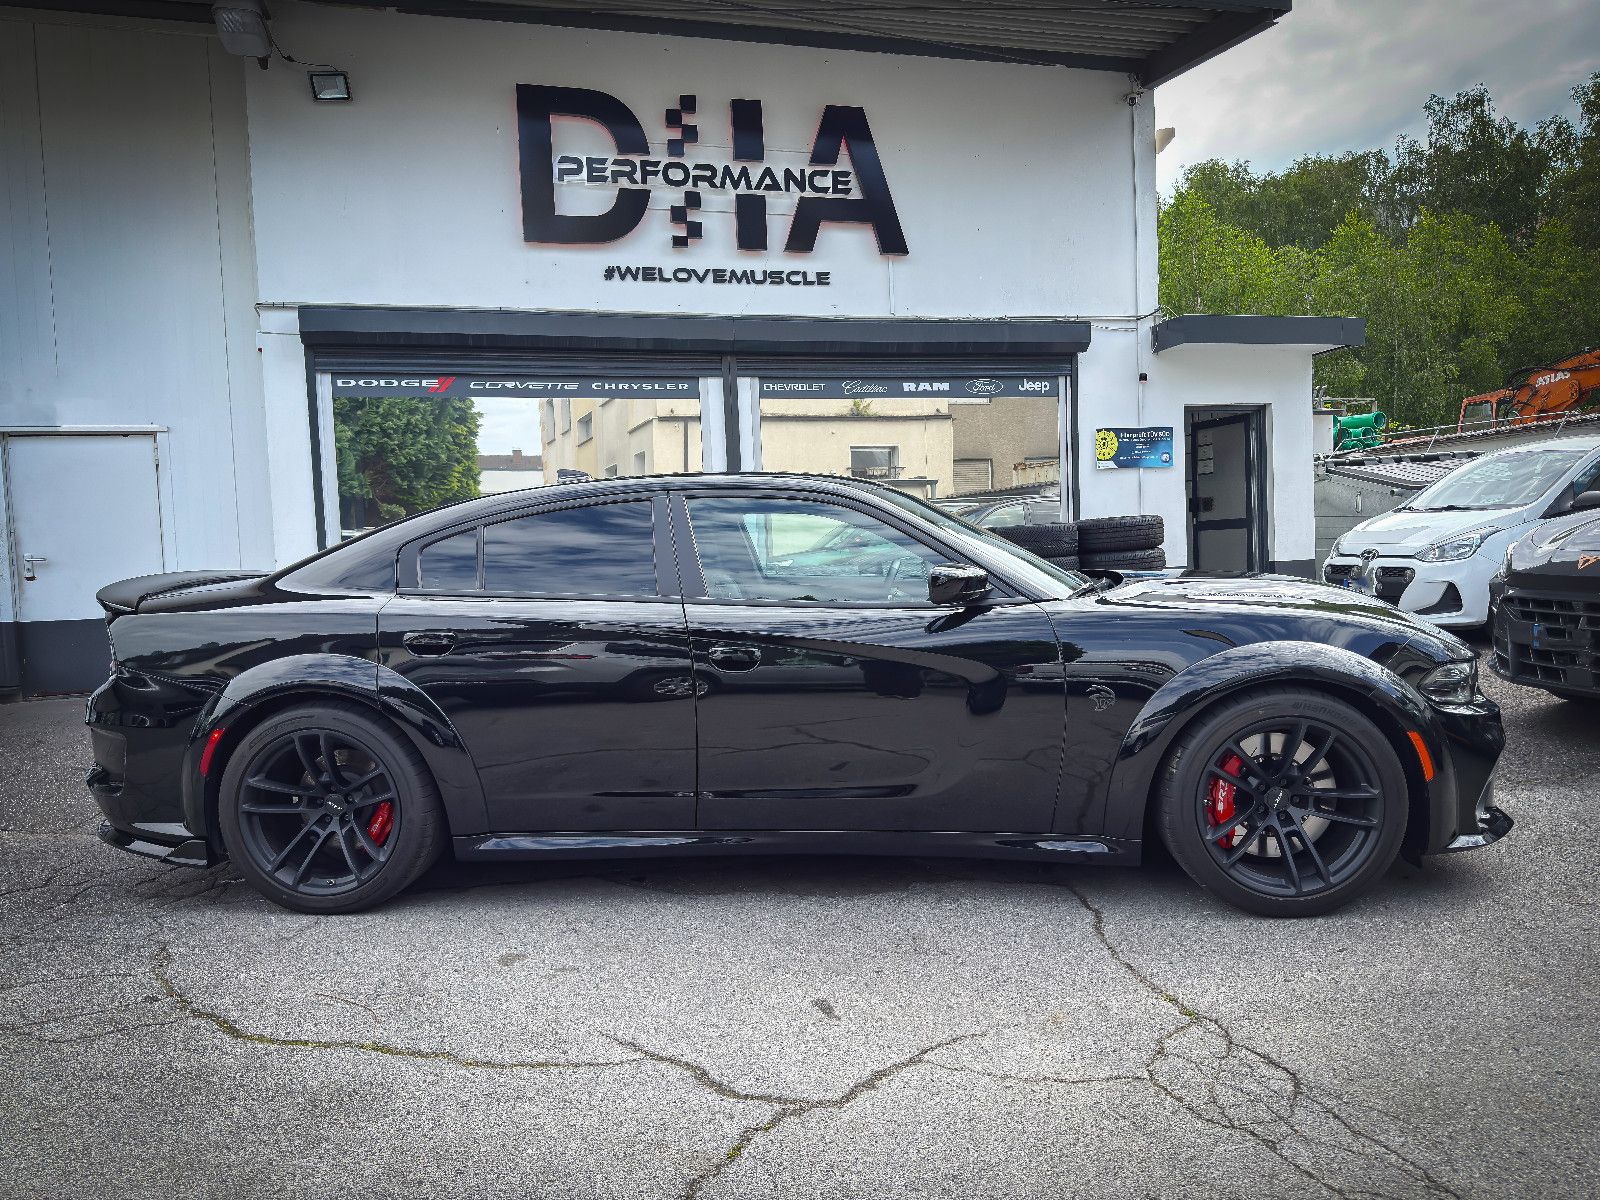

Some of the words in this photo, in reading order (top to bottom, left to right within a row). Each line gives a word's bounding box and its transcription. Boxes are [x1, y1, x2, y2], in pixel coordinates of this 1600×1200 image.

[556, 155, 853, 195] PERFORMANCE
[603, 264, 831, 286] #WELOVEMUSCLE
[336, 379, 440, 387] DODGE
[1018, 378, 1050, 393] Jeep
[1535, 371, 1571, 388] ATLAS
[469, 381, 580, 391] CORVETTE
[591, 383, 690, 391] CHRYSLER
[763, 383, 826, 391] CHEVROLET
[841, 379, 889, 394] Cadillac
[902, 382, 950, 392] RAM
